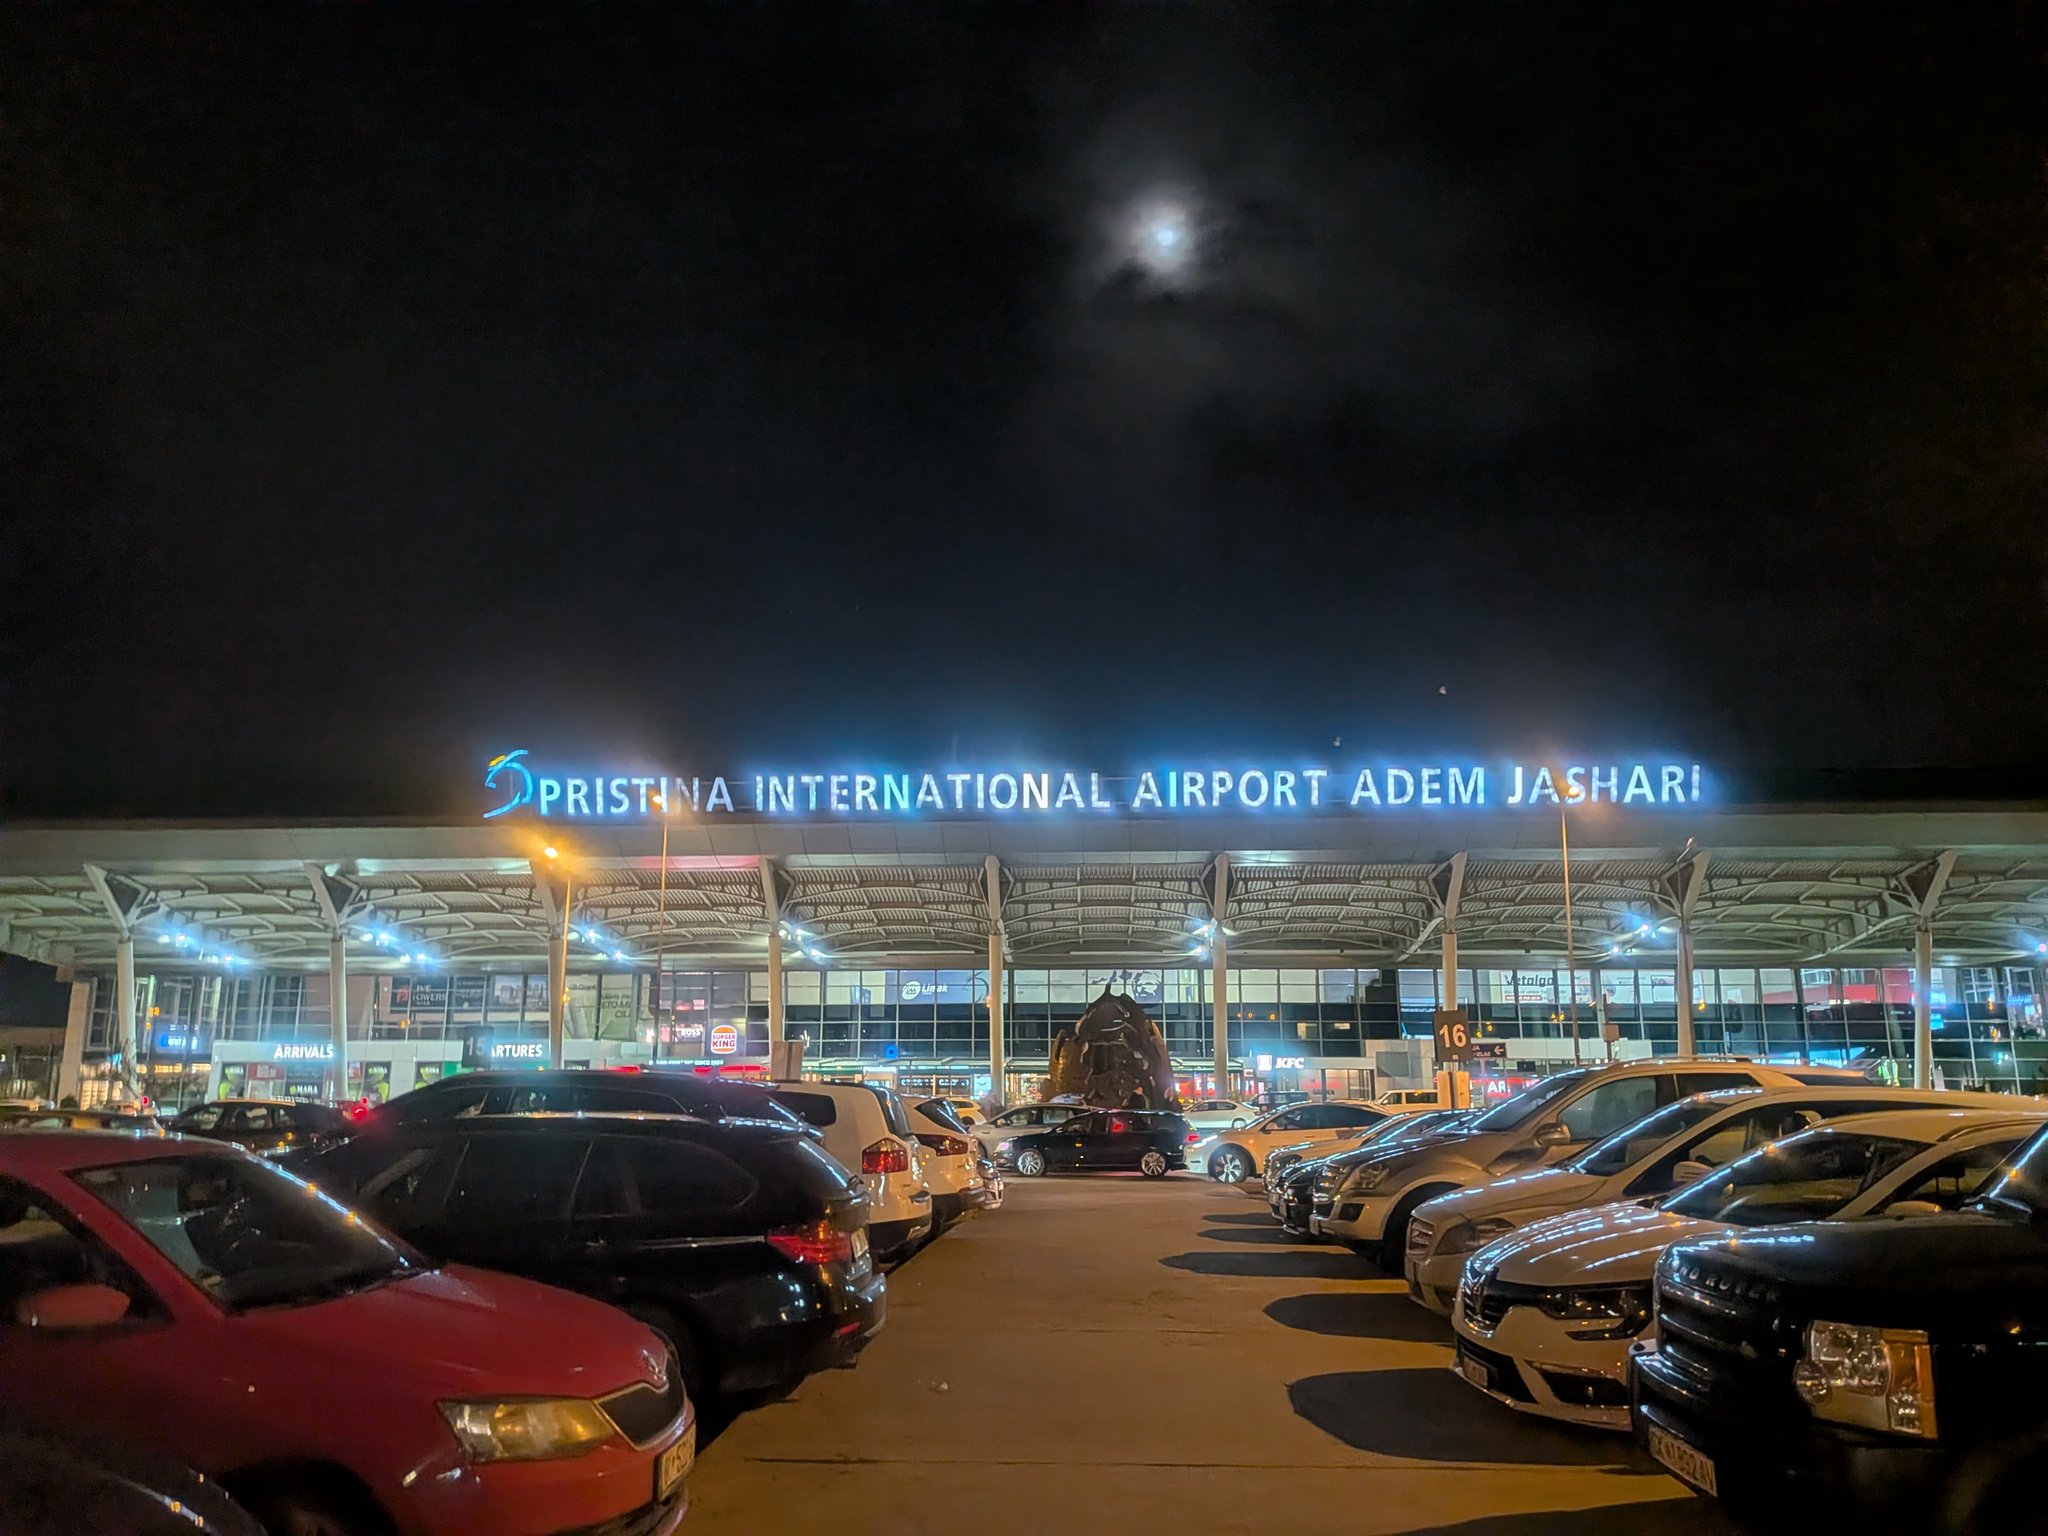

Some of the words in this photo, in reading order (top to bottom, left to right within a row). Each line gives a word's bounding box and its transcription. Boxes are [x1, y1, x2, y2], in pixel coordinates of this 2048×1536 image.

[539, 776, 735, 816] PRISTINA
[754, 771, 1111, 815] INTERNATIONAL
[1132, 768, 1328, 809] AIRPORT
[1350, 766, 1486, 807] ADEM
[1507, 764, 1701, 807] JASHARI
[712, 1040, 736, 1048] KING
[1439, 1023, 1467, 1048] 16
[273, 1043, 335, 1059] ARRIVALS
[465, 1035, 486, 1057] 15
[1275, 1057, 1305, 1069] KFC
